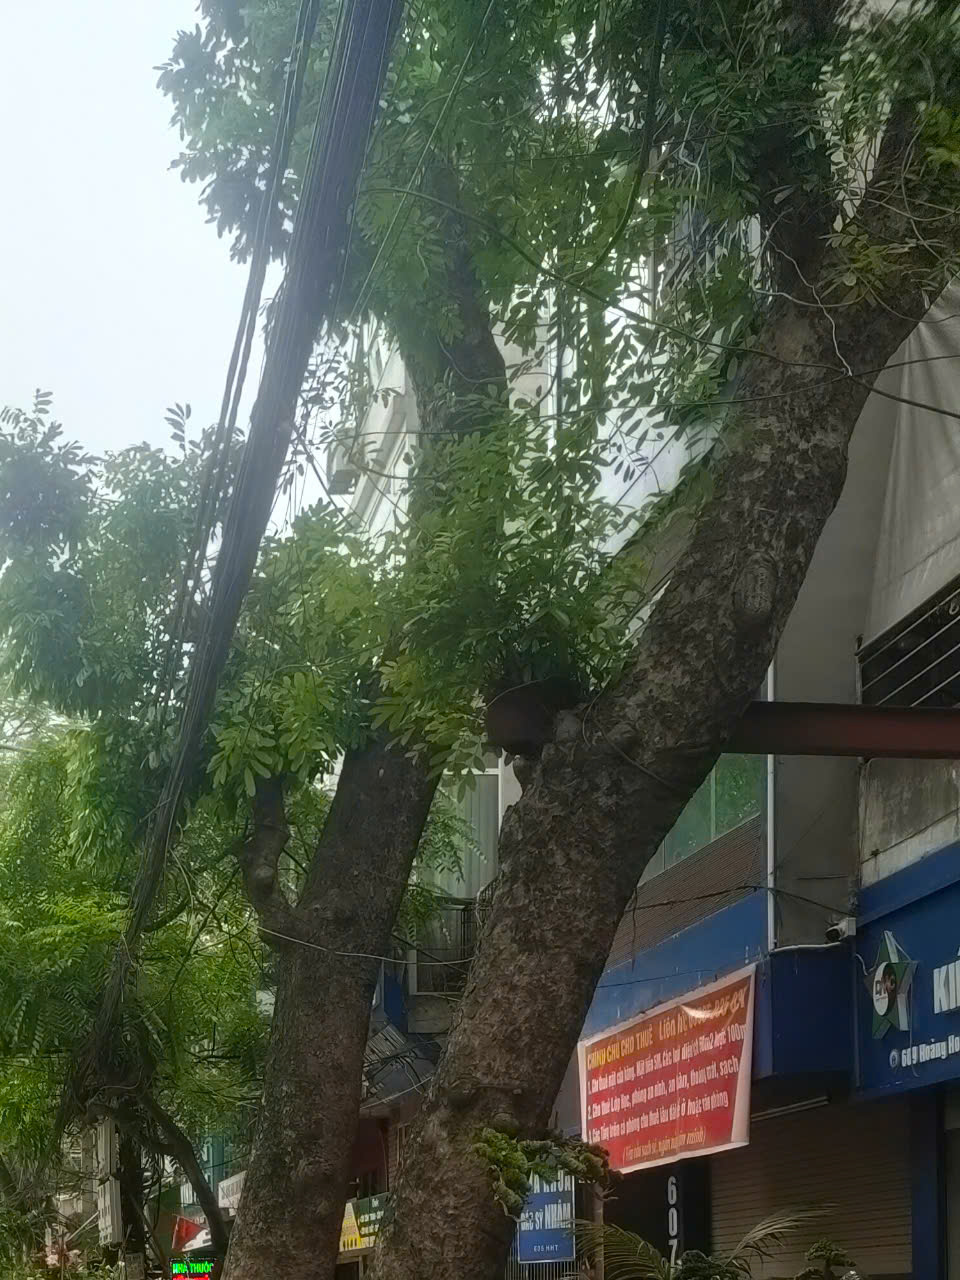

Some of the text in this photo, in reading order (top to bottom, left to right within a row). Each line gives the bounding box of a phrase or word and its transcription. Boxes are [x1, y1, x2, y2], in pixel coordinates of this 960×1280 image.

[660, 1016, 676, 1040] Liên
[919, 1038, 948, 1061] Hoàng
[720, 1055, 739, 1078] sạch
